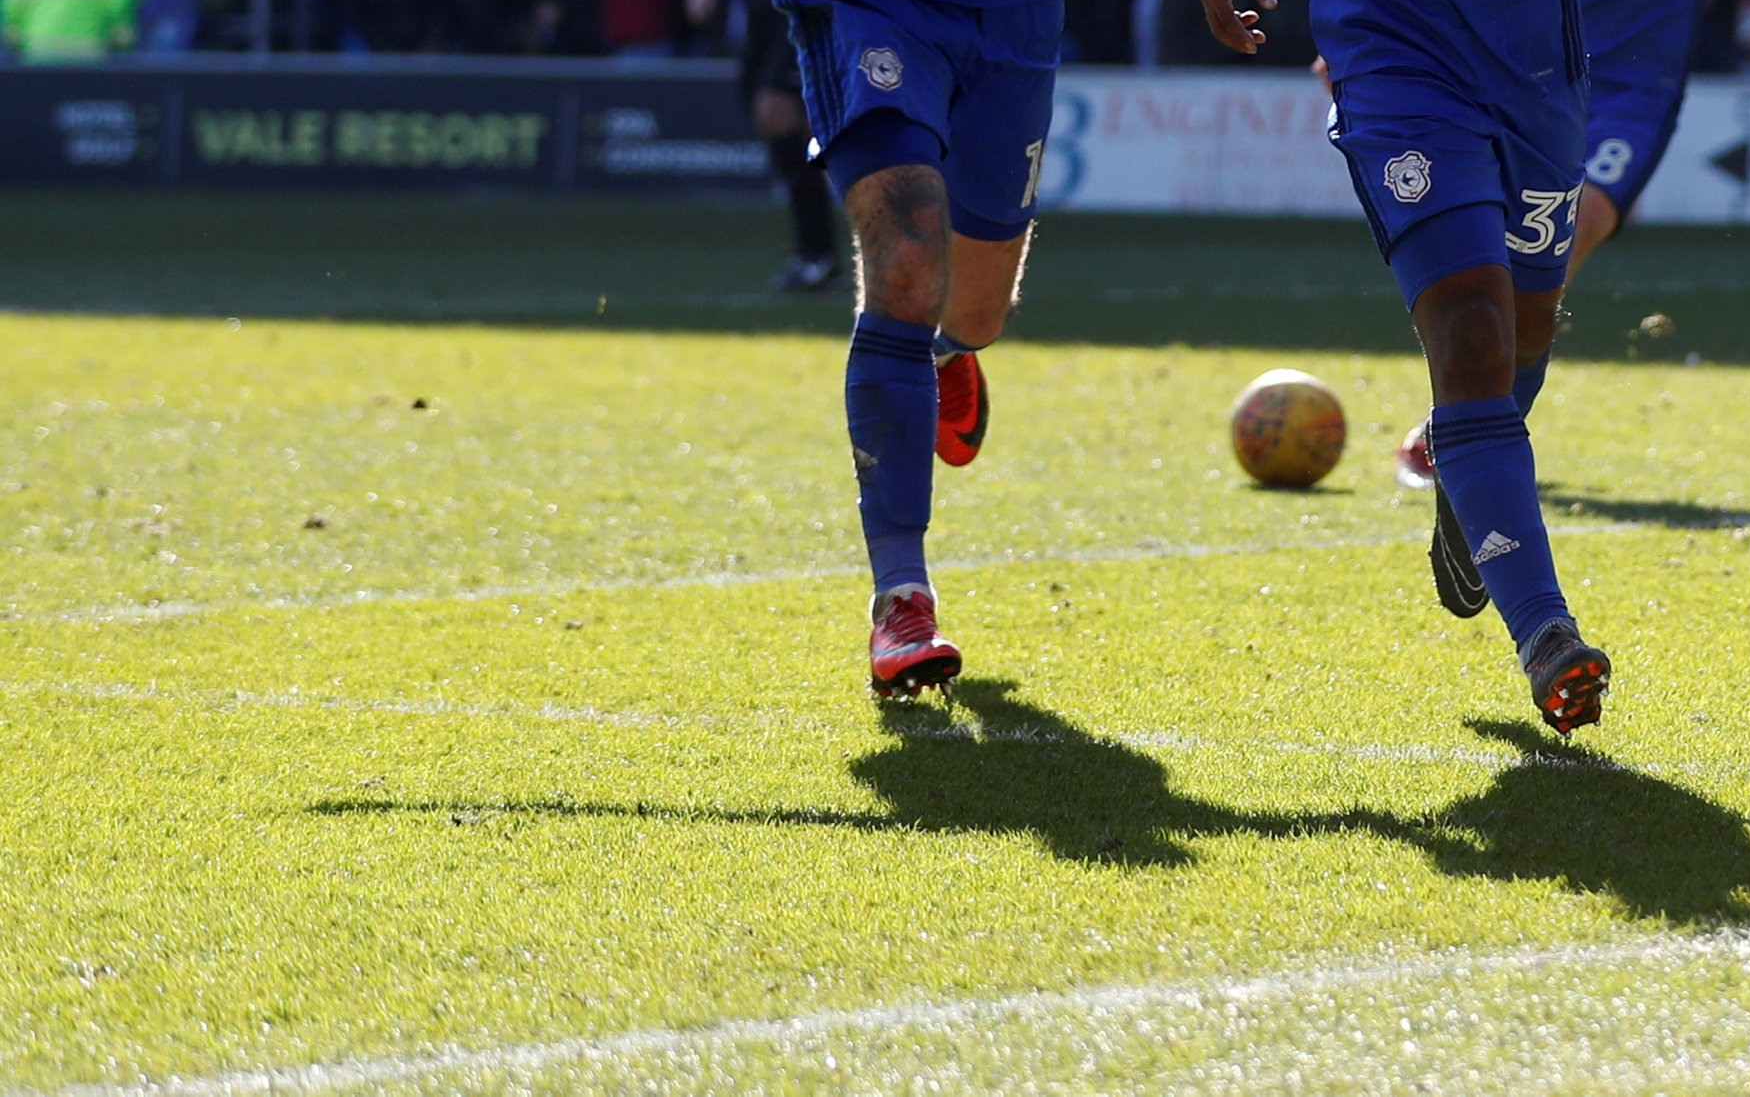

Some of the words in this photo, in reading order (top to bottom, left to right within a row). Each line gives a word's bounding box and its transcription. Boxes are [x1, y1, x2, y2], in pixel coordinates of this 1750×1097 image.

[195, 111, 327, 164] VALE
[336, 111, 548, 168] RESORT
[1586, 138, 1634, 185] 8
[1021, 138, 1046, 209] 1
[1473, 540, 1520, 565] adidas
